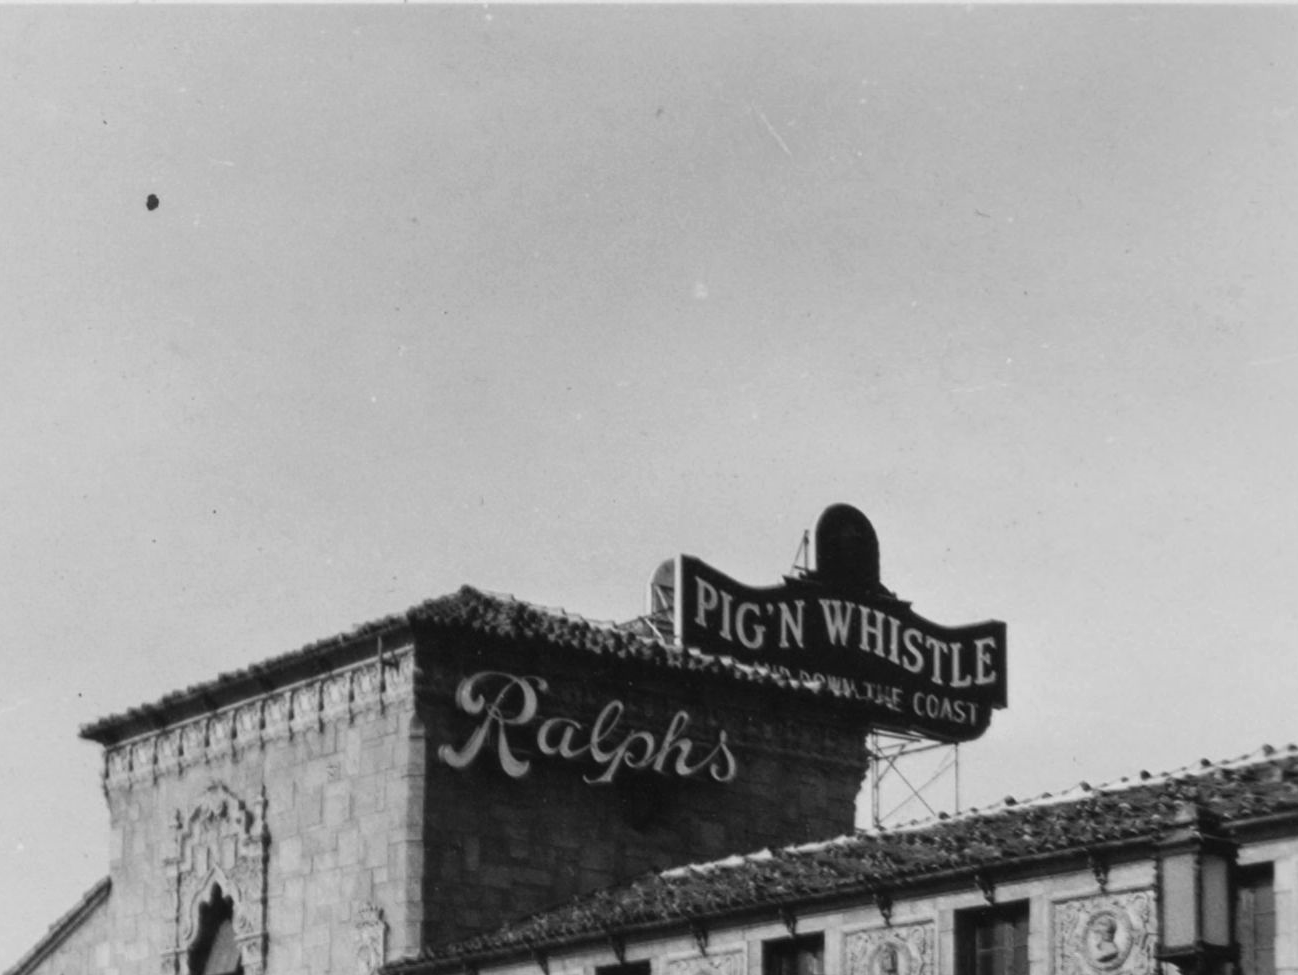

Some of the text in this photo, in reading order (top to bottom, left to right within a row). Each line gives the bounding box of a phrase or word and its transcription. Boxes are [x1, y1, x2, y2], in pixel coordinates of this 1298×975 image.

[694, 575, 997, 688] PIG'N WHISTLE
[437, 670, 736, 784] Ralphs
[862, 681, 903, 708] THE
[913, 691, 979, 726] COAST
